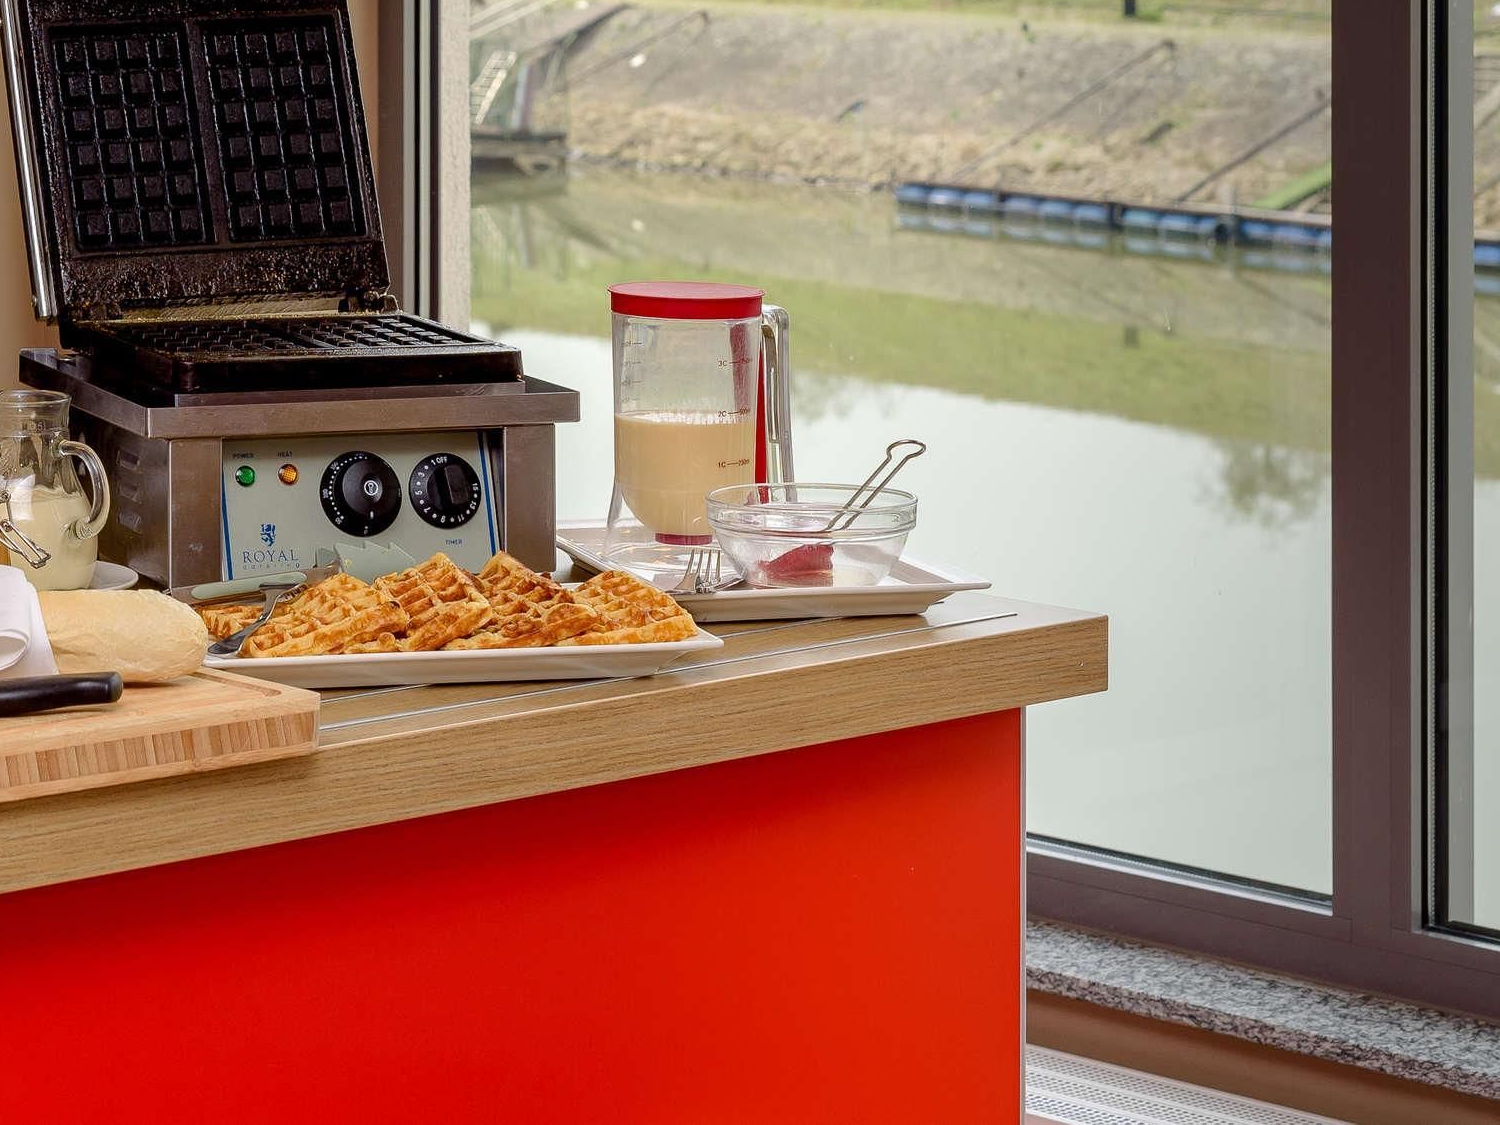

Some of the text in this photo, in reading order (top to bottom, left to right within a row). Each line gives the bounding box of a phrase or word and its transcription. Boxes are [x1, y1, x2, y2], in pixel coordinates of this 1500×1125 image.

[435, 456, 448, 464] OFF
[445, 539, 463, 547] TIMER
[242, 549, 299, 564] ROYAL
